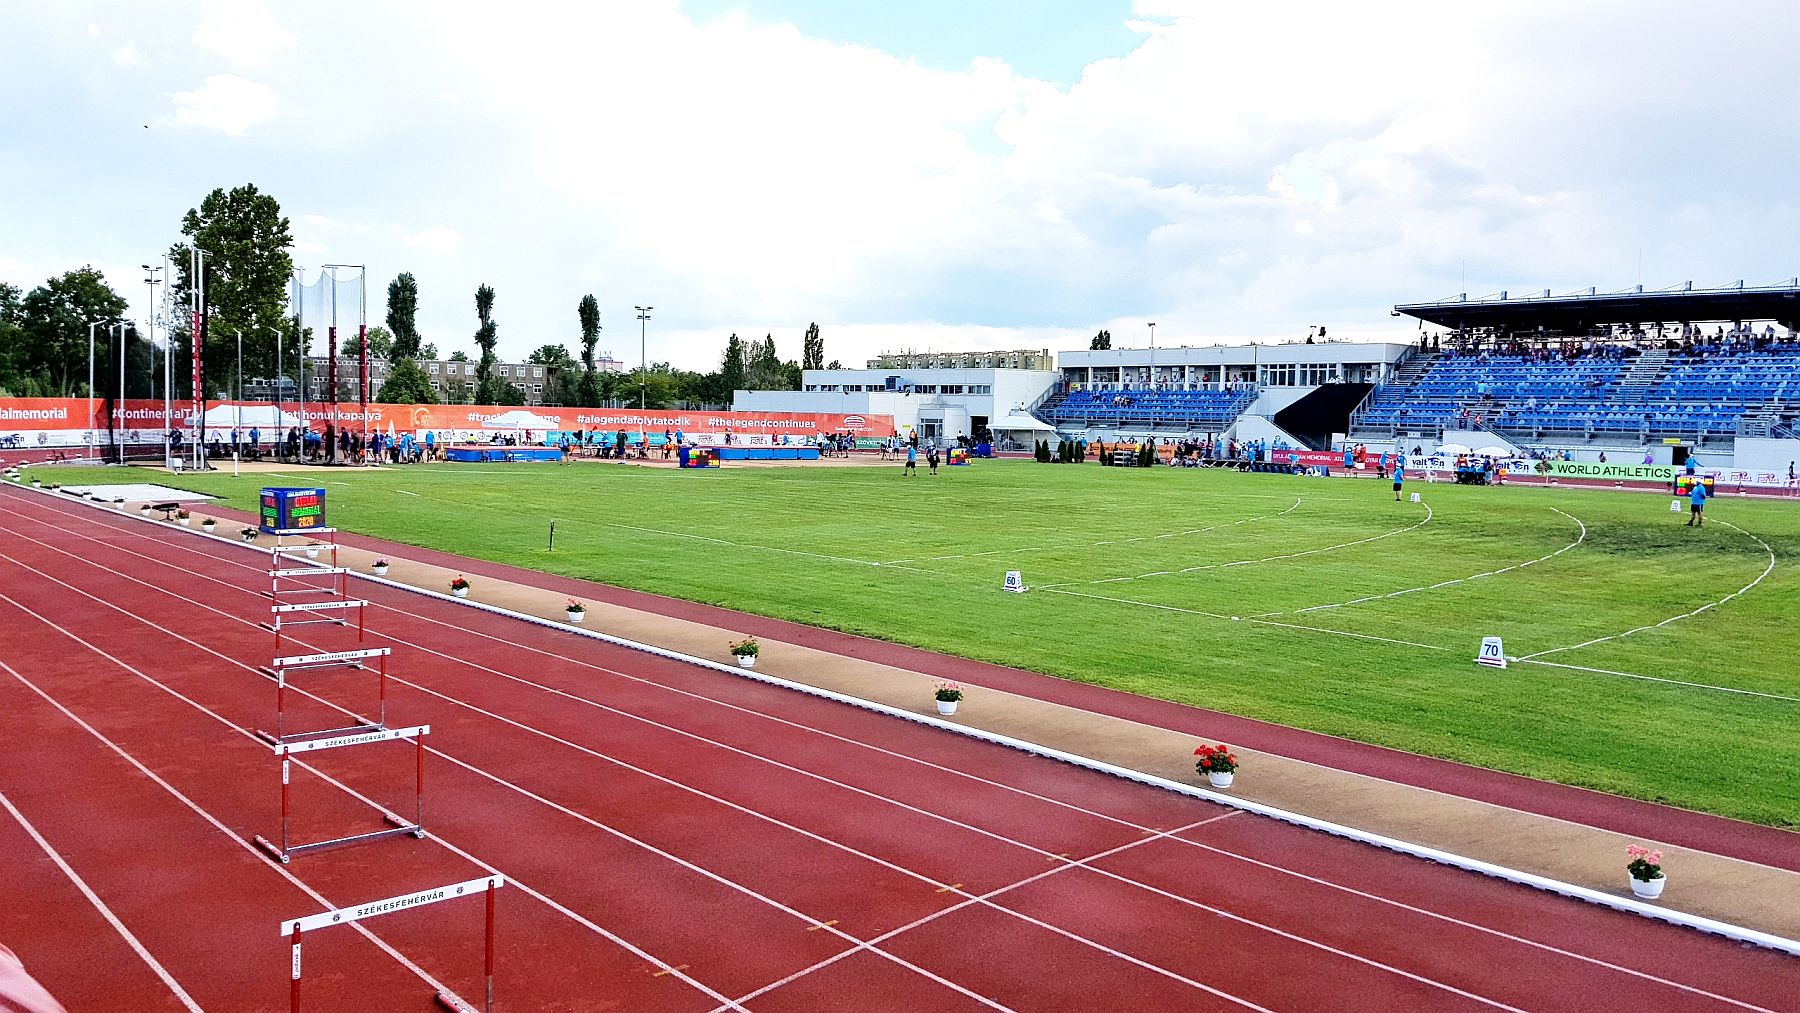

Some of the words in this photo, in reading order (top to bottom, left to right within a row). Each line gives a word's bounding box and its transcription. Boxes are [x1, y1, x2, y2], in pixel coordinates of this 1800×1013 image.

[1557, 464, 1600, 475] WORLD
[1602, 466, 1672, 478] ATHLETICS
[1006, 576, 1016, 586] 60
[1484, 643, 1499, 657] 70
[357, 890, 444, 917] SZÉKESFEHÉRVÁR
